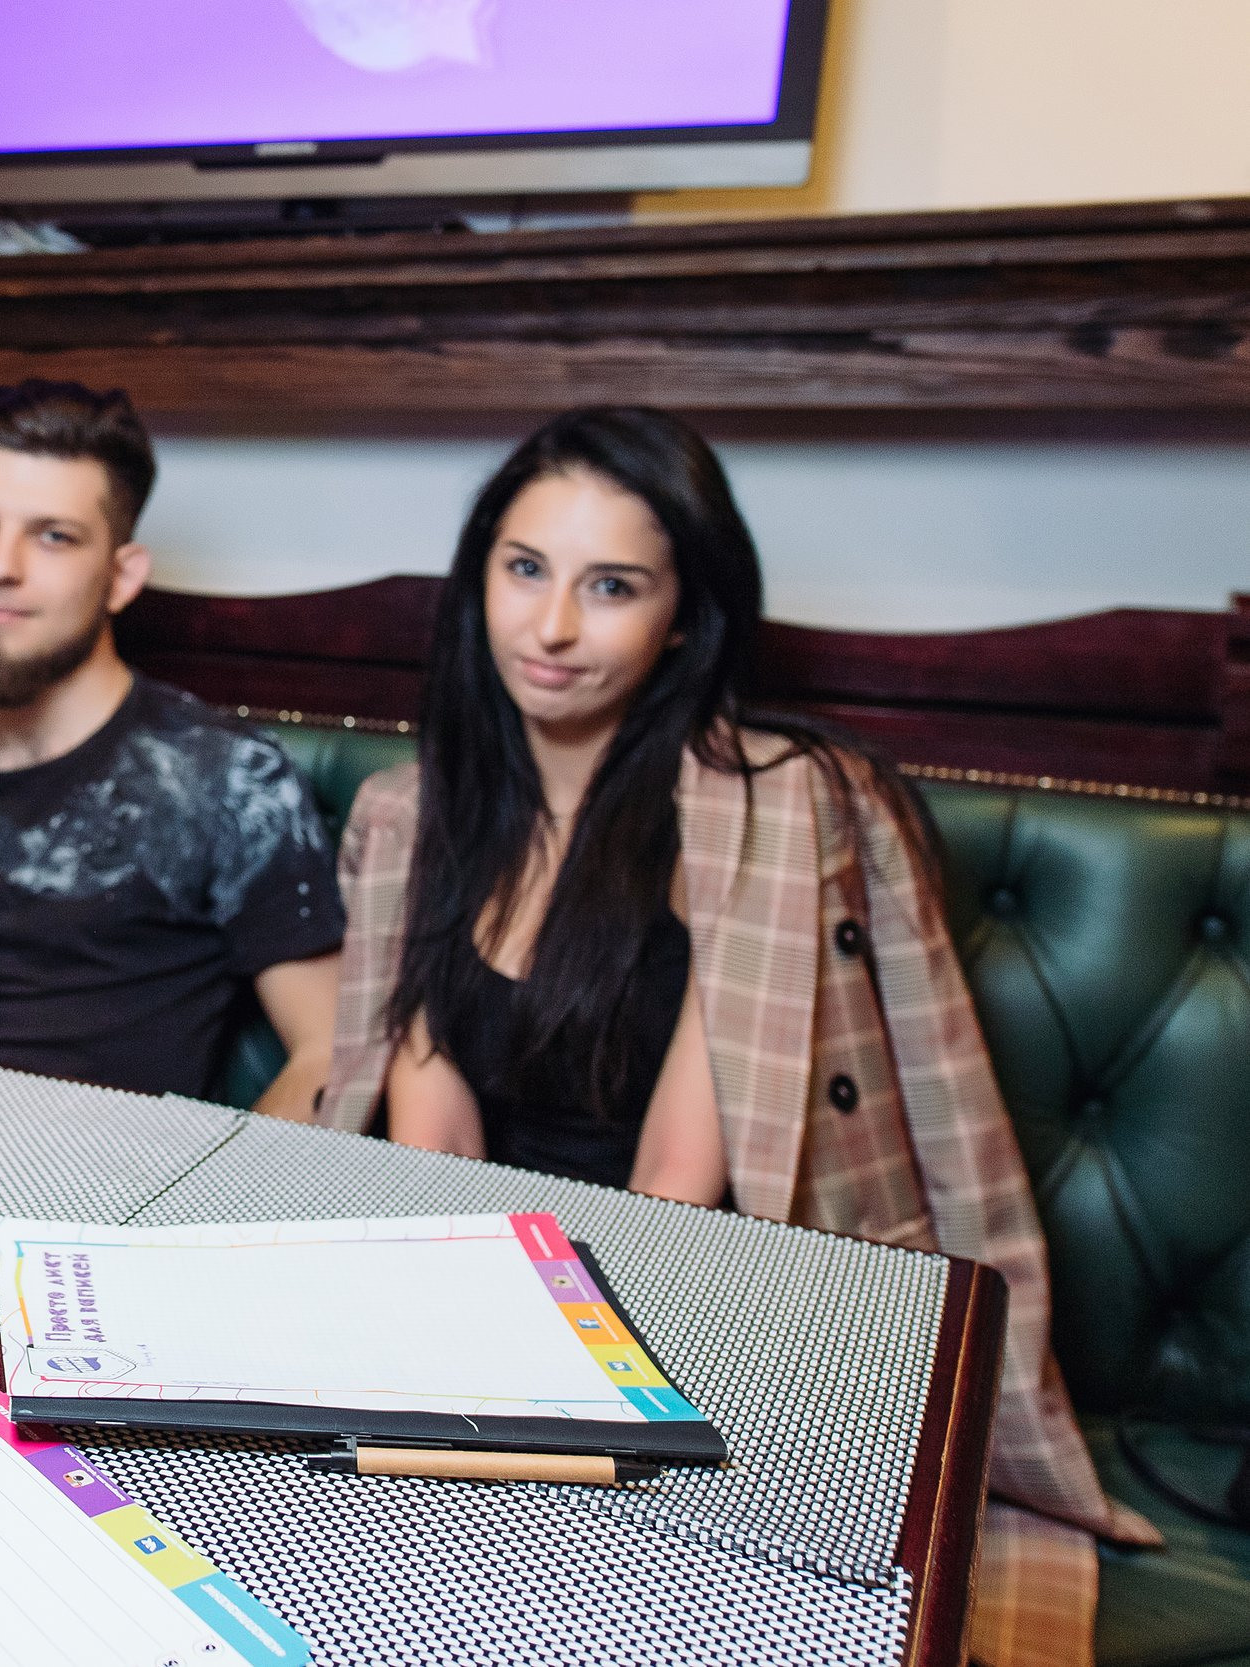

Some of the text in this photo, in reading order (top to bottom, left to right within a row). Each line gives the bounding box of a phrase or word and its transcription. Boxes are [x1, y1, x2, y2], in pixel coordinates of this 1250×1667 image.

[44, 1251, 66, 1286] лист
[44, 1291, 75, 1342] Просто
[80, 1318, 107, 1343] для
